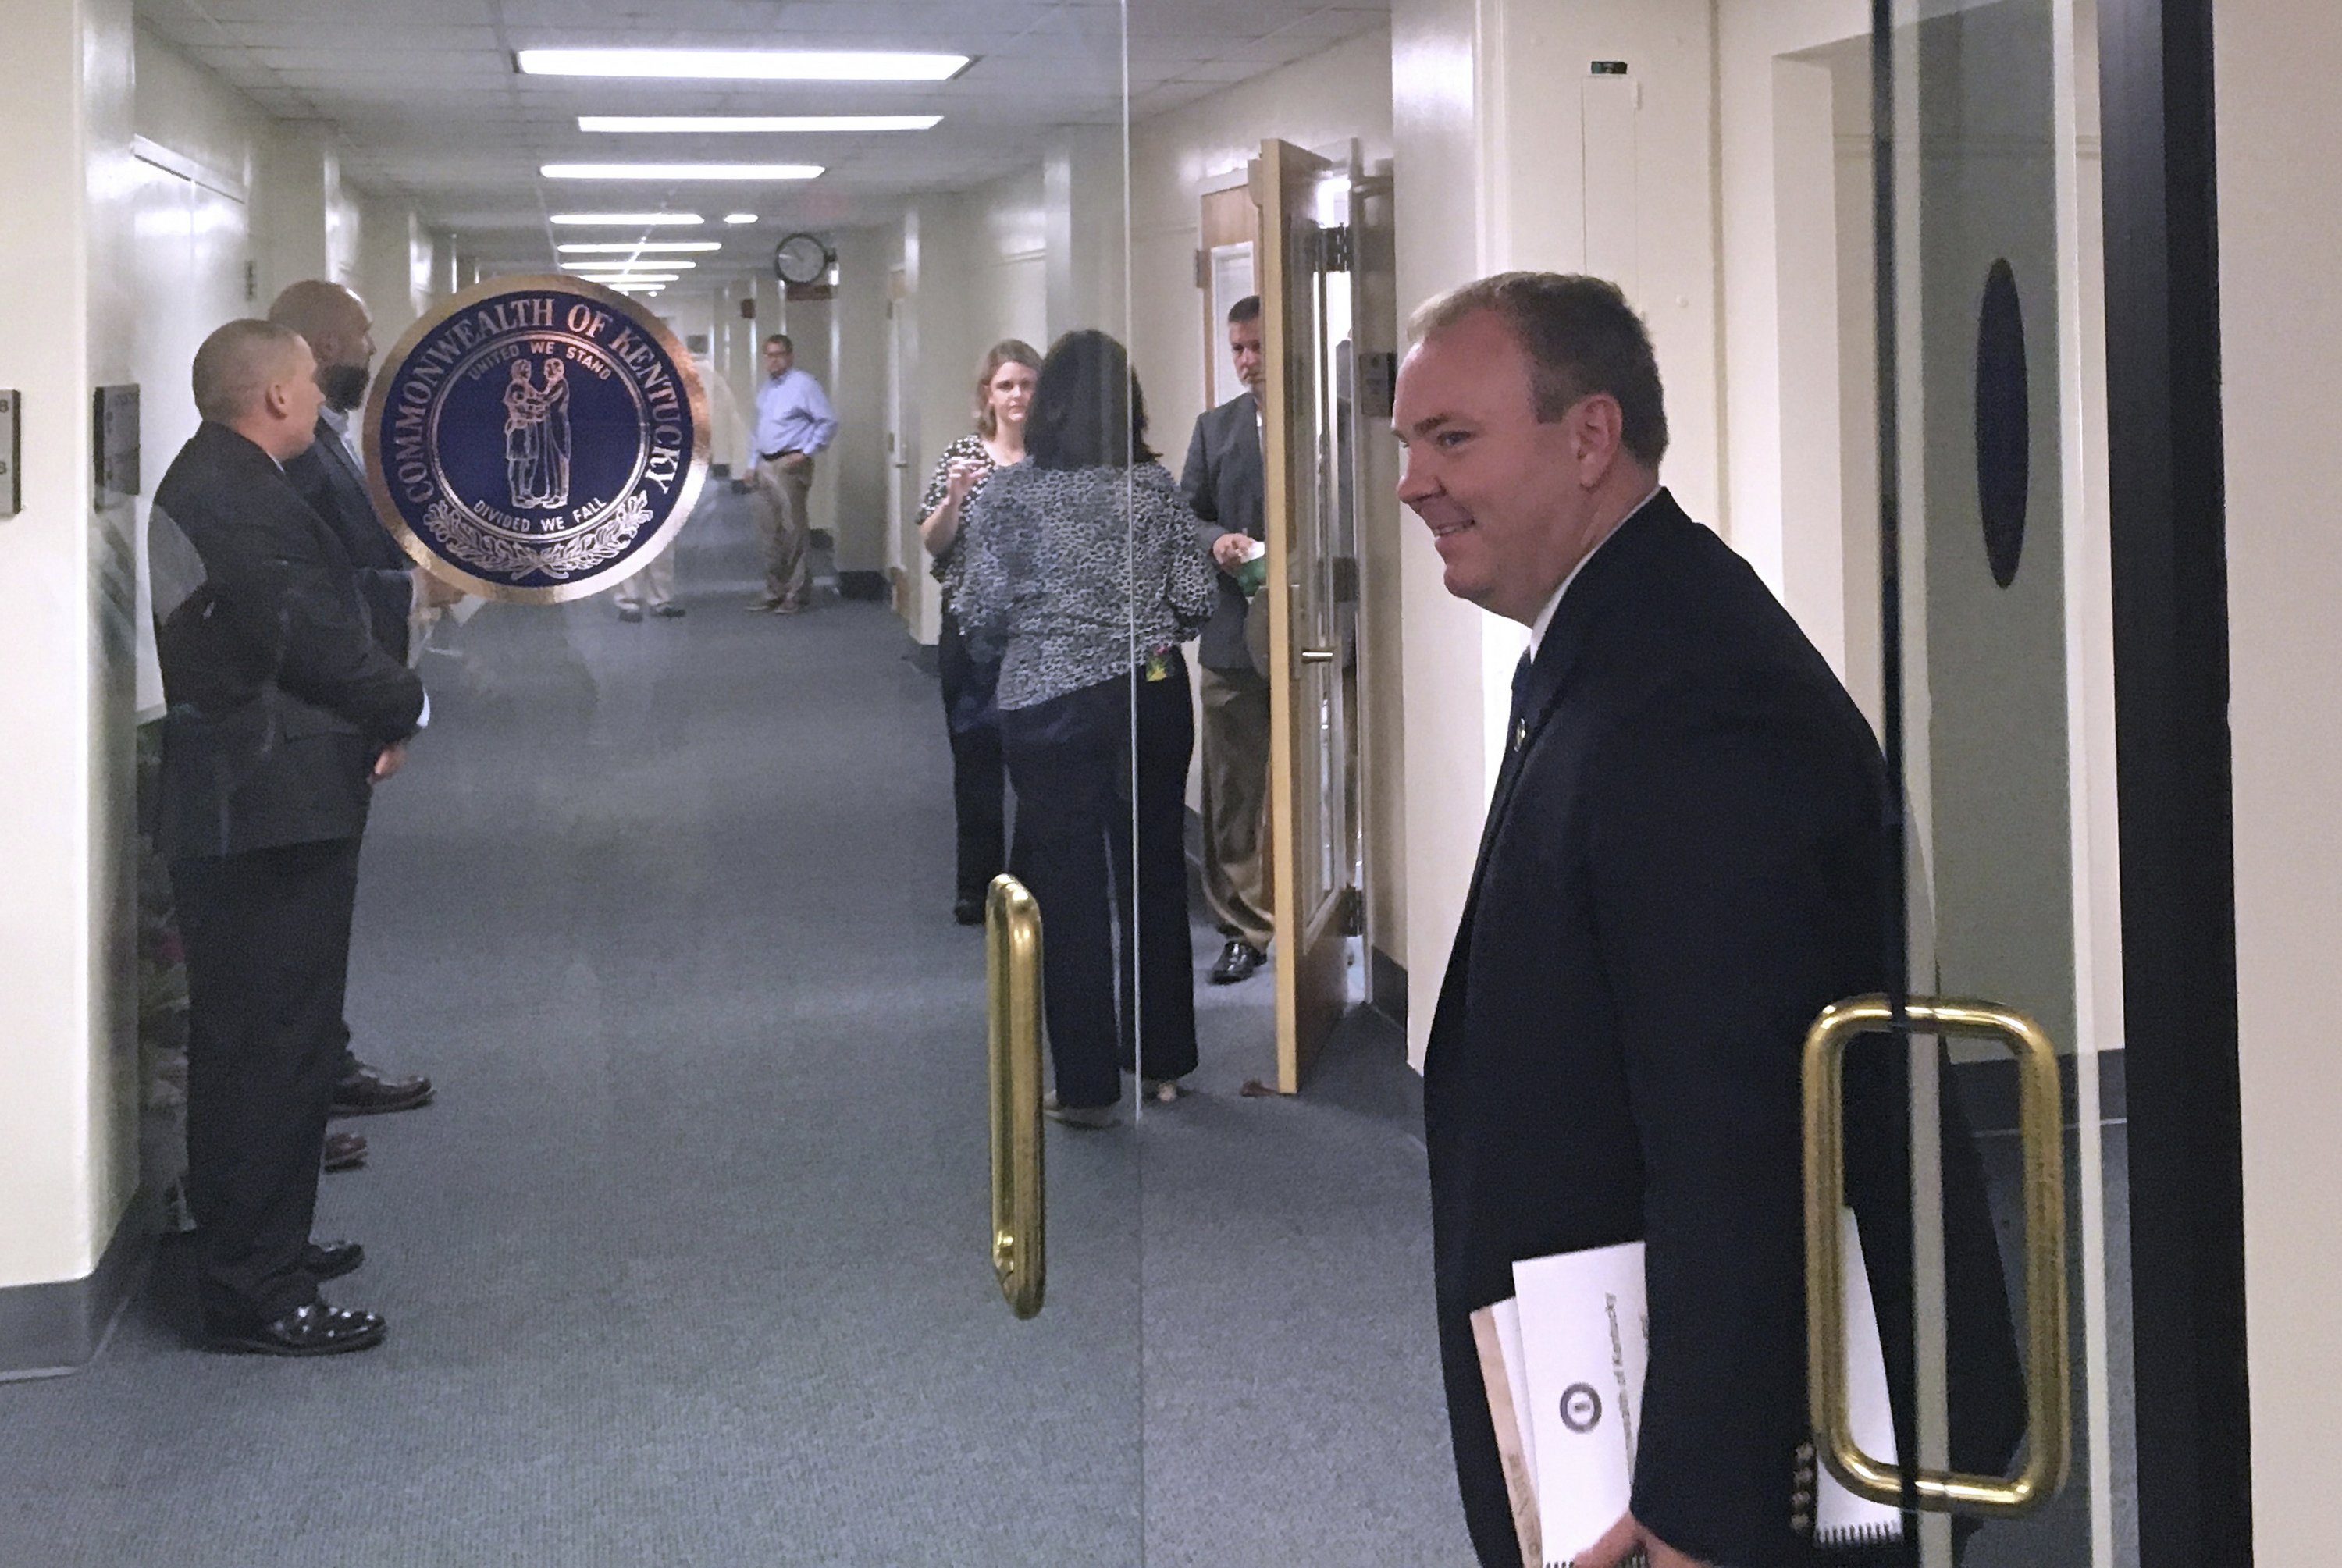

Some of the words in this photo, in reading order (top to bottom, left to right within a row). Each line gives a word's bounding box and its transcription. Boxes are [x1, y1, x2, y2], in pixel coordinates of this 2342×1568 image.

[468, 343, 520, 381] UNITED
[529, 341, 555, 354] WE
[566, 346, 612, 381] STAND
[394, 298, 555, 503] COMMONWEALTH
[568, 303, 614, 338] OF
[608, 325, 682, 494] KENTUCKY
[473, 500, 531, 532] DIVIDED
[540, 516, 565, 532] WE
[572, 497, 607, 524] FALL
